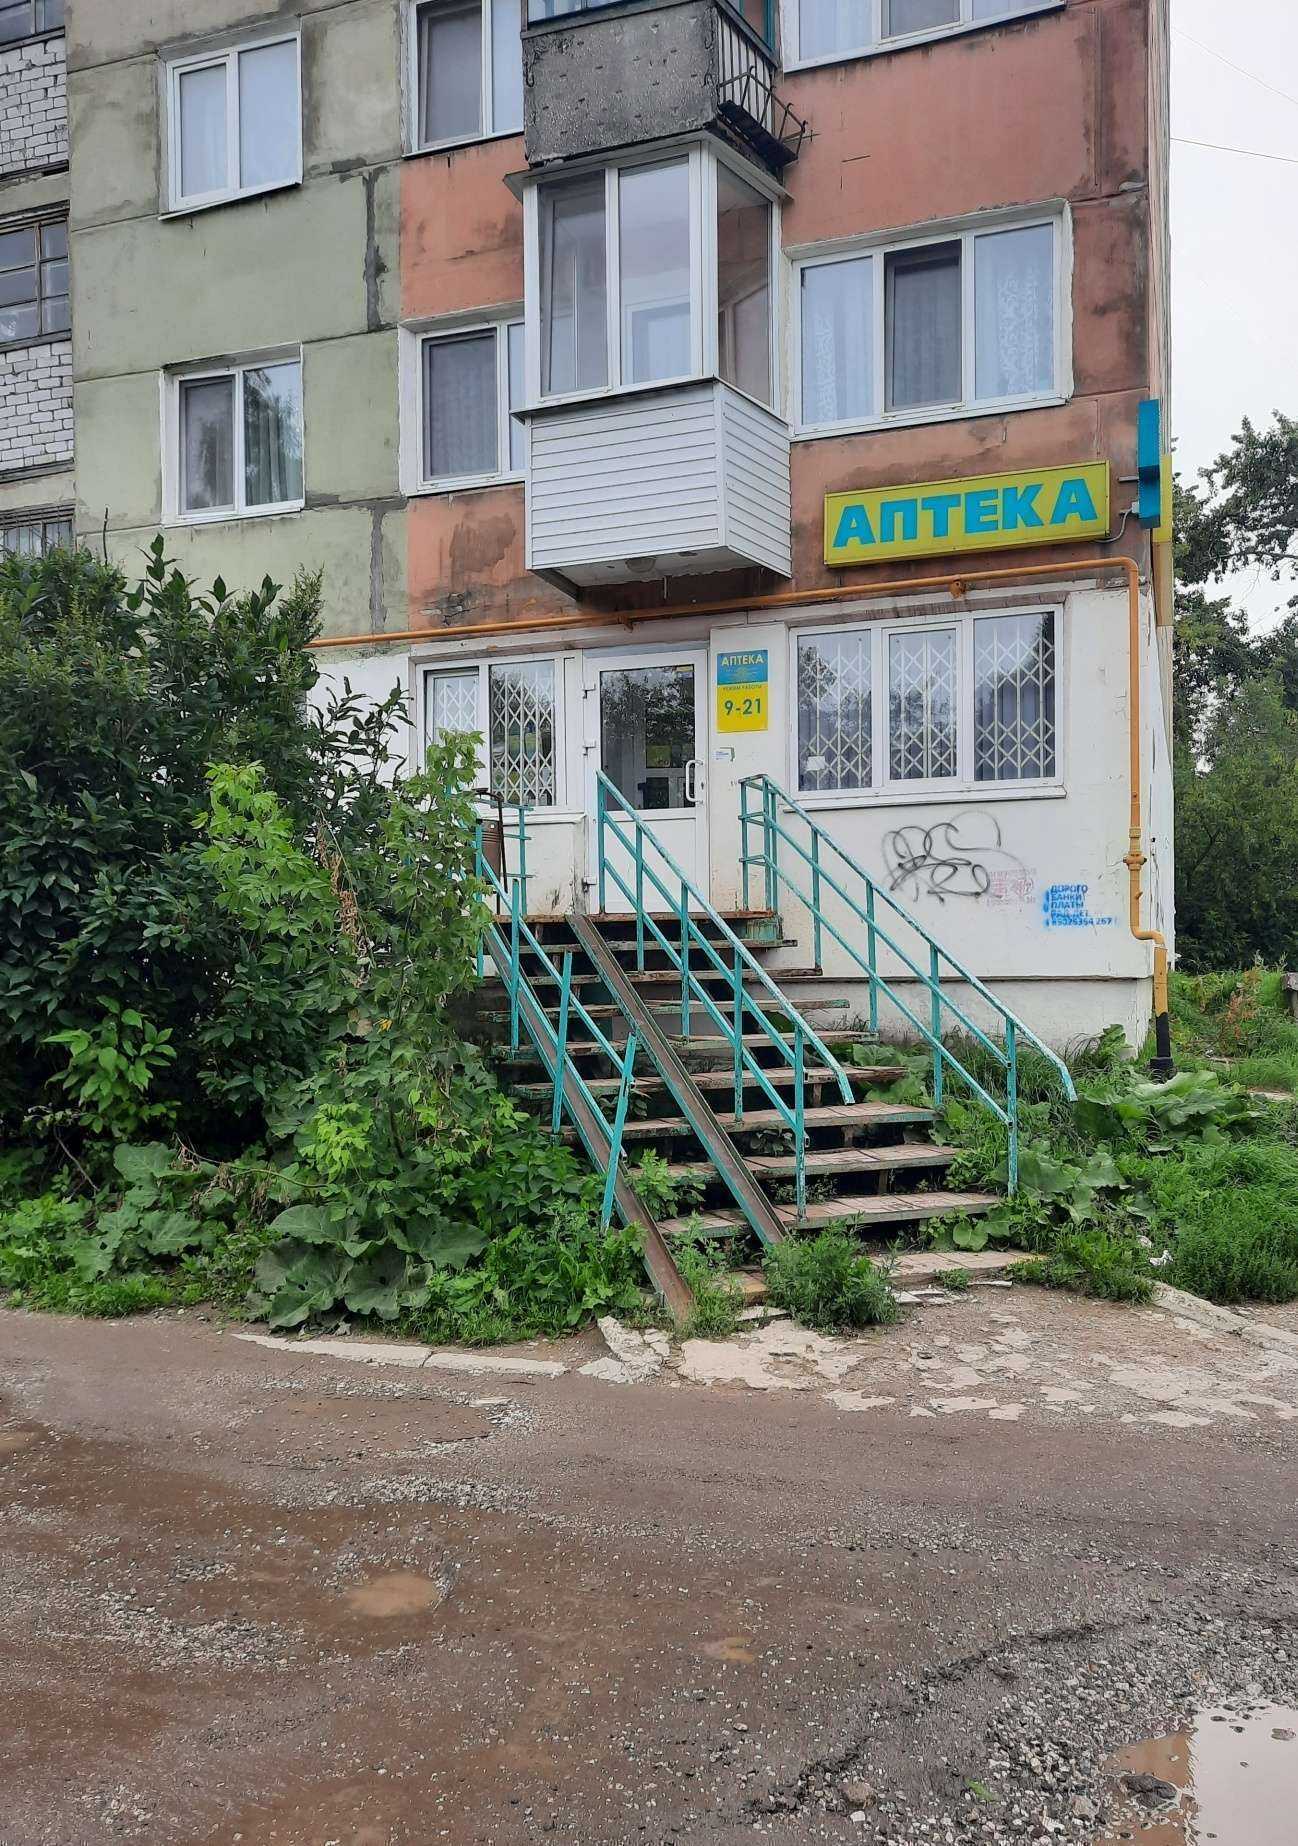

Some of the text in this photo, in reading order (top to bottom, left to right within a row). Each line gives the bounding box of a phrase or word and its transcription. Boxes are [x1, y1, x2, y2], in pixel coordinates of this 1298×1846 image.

[832, 478, 1098, 548] АПТЕКА
[721, 654, 764, 667] АПТЕКА
[724, 698, 761, 716] 9-21
[1051, 885, 1088, 894] ДОРОГО
[1051, 901, 1084, 909] ПЛАТЫ
